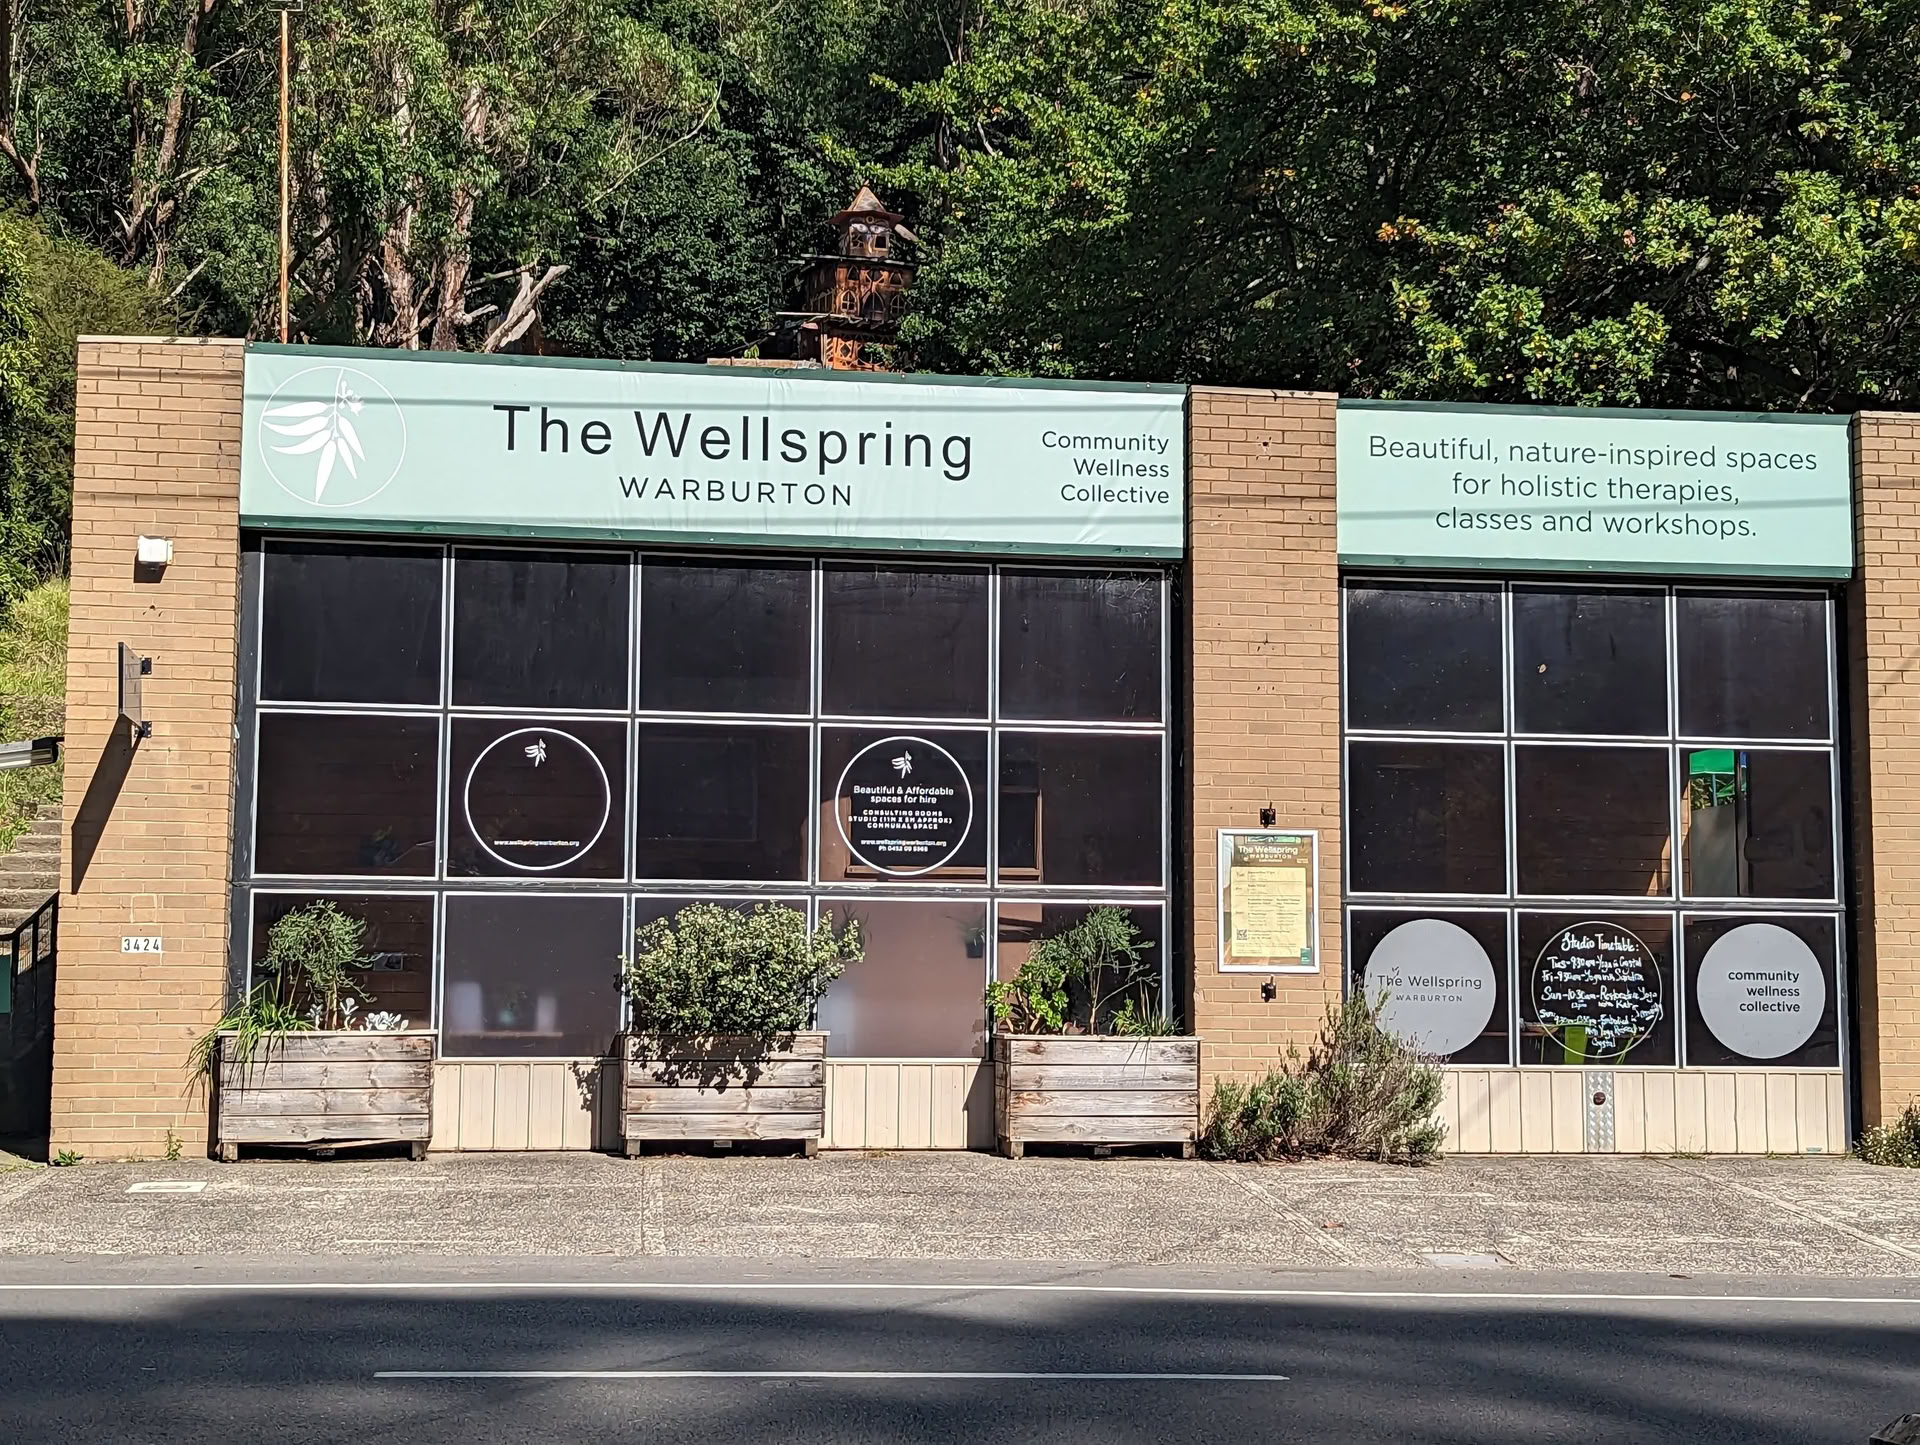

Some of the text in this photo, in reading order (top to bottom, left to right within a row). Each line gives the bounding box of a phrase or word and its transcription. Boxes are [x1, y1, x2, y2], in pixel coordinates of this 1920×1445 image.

[492, 404, 972, 483] The Wellspring
[1042, 430, 1169, 456] Community
[1370, 435, 1817, 472] Beautiful, nature-inspired spaces
[1073, 458, 1170, 478] Wellness
[618, 476, 851, 507] WARBURTON
[1060, 484, 1170, 504] Collective
[1452, 472, 1739, 505] for holistic therapies,
[1435, 506, 1757, 540] classes and workshops.
[853, 785, 954, 796] Beautiful & Affordable
[870, 795, 937, 804] spaces for hire
[867, 822, 912, 830] COMMUNAL
[124, 938, 160, 951] 3424
[1561, 932, 1595, 951] Studio
[1377, 974, 1482, 990] The Wellspring
[1728, 970, 1800, 983] community
[1395, 994, 1463, 1002] WARBURTON
[1747, 985, 1800, 996] wellness
[1740, 1000, 1800, 1012] collective
